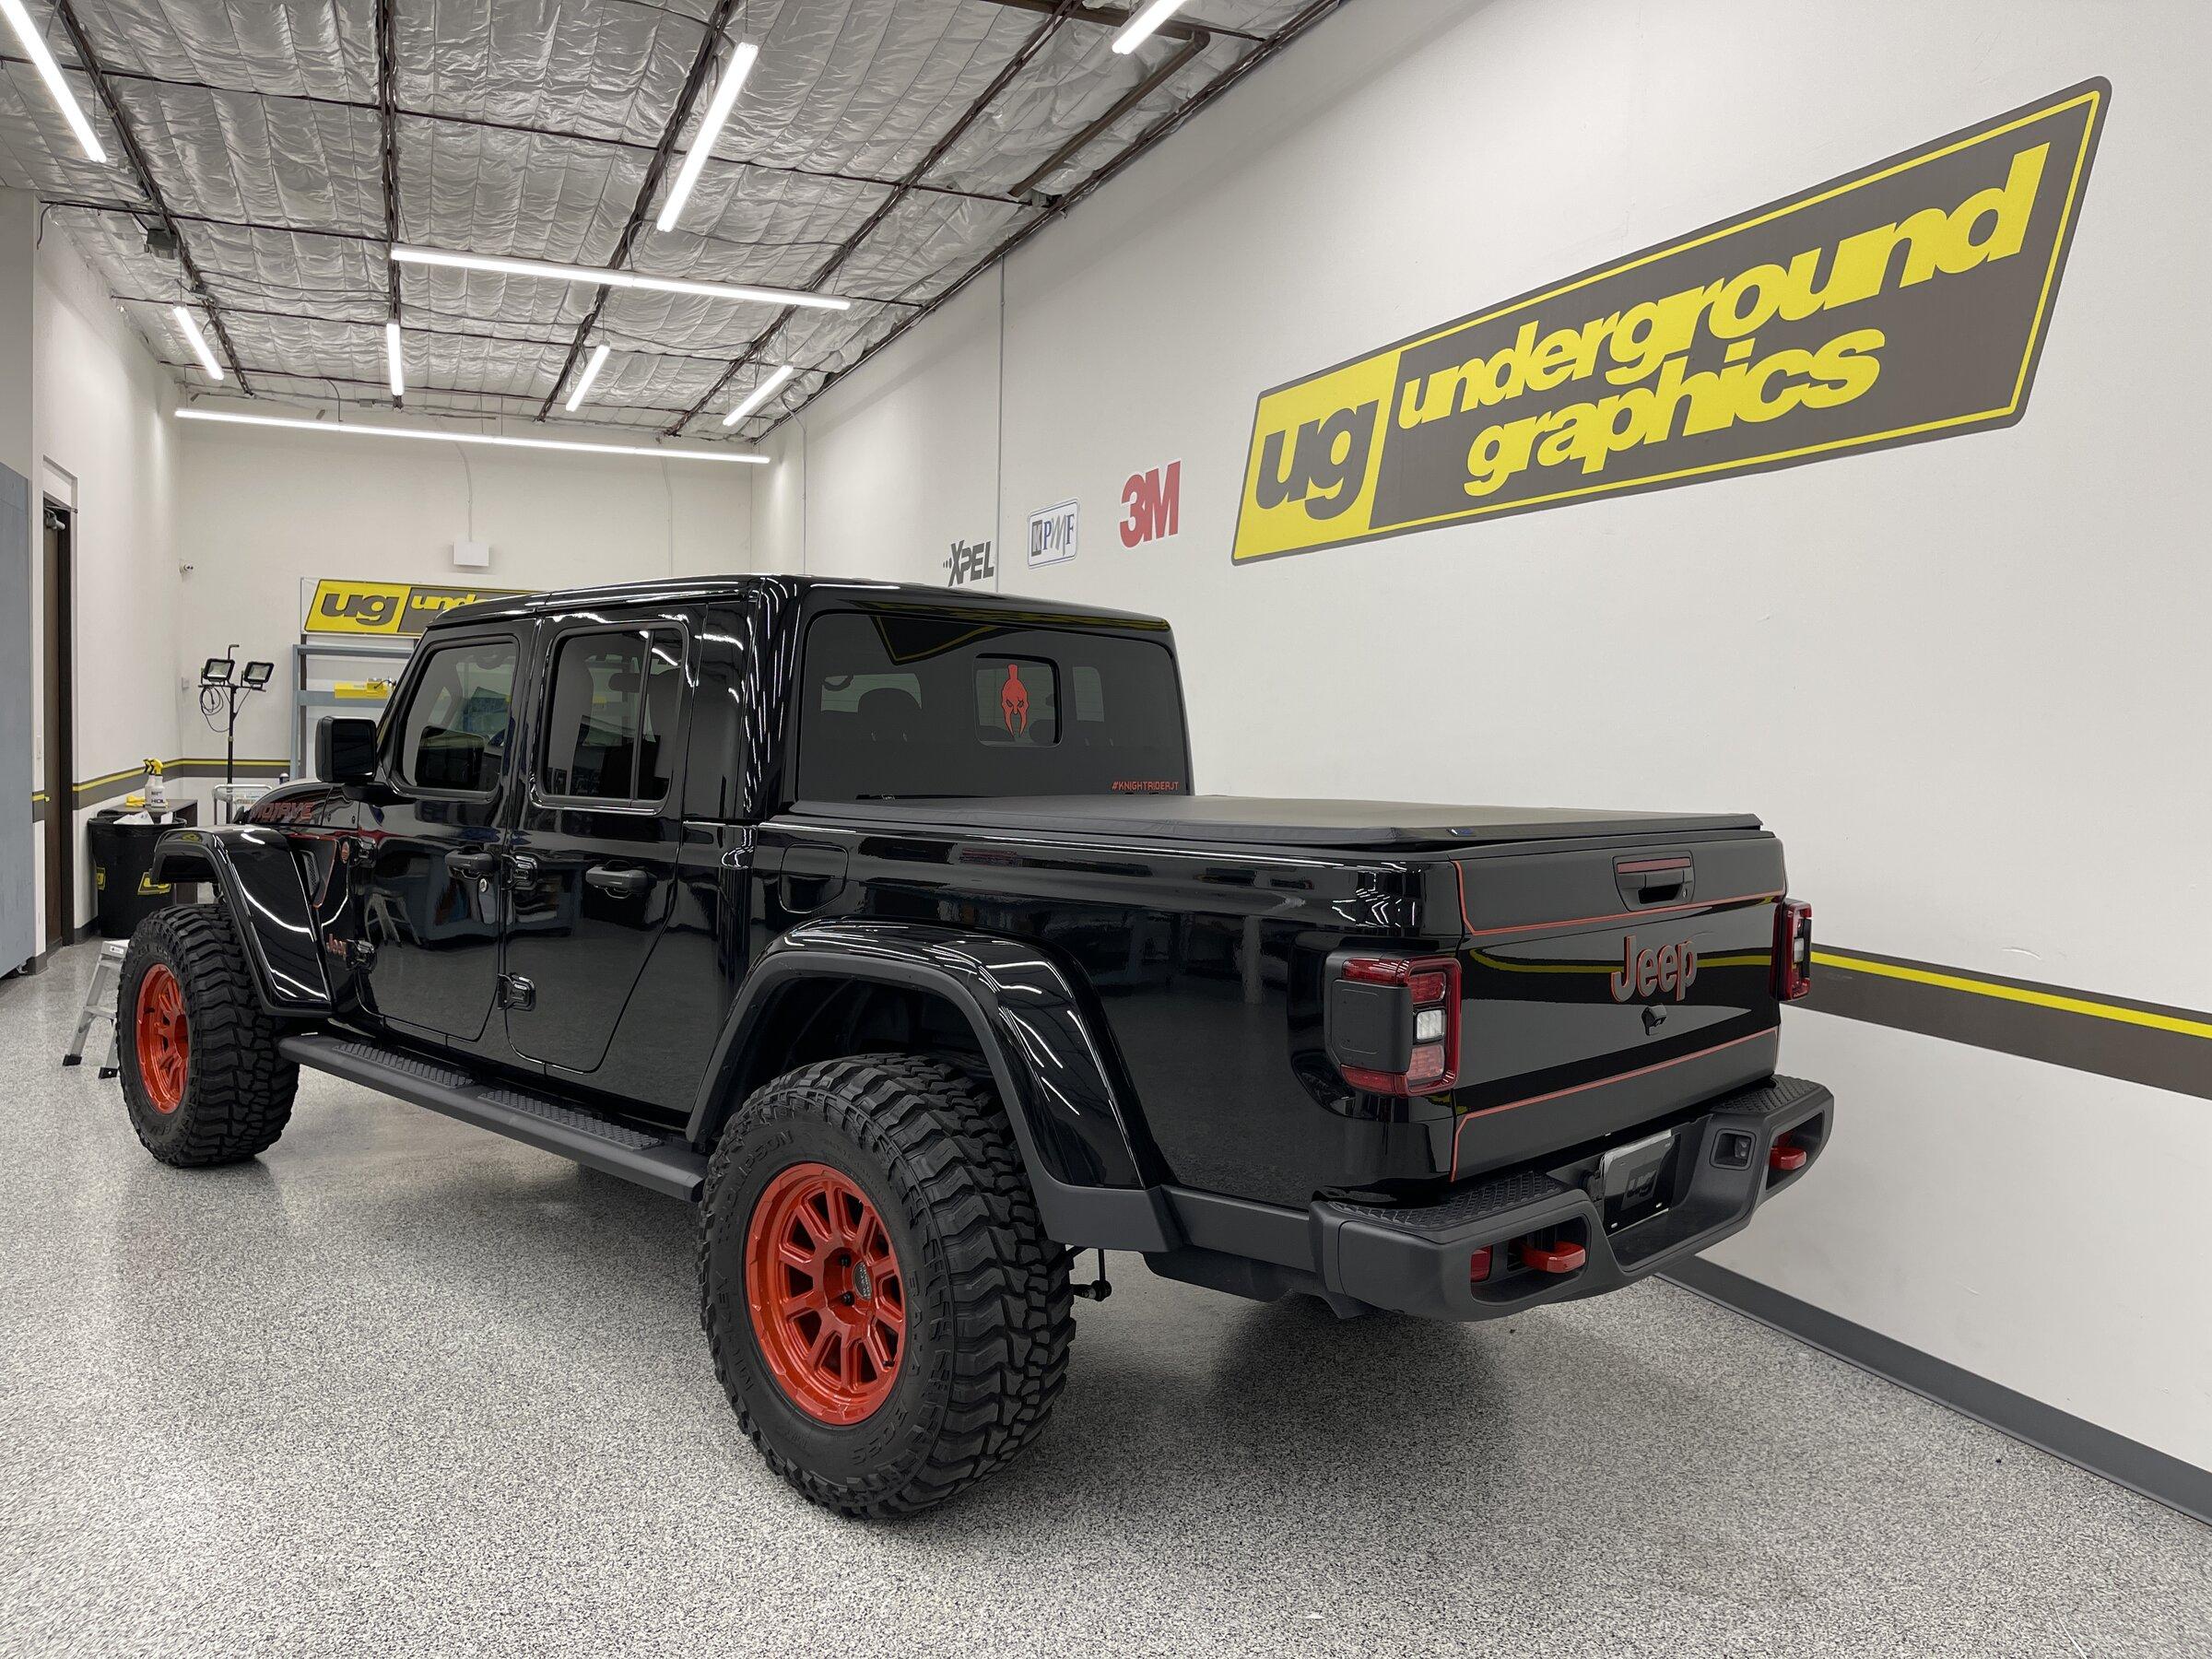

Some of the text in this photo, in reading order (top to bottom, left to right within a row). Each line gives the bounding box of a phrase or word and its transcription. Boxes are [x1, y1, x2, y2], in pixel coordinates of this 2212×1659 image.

[1398, 141, 2051, 429] underground
[1464, 328, 1885, 495] graphics
[1256, 398, 1378, 519] ug
[1030, 513, 1075, 558] KPMF
[1119, 460, 1181, 547] 3M
[947, 539, 994, 587] XPEL
[321, 593, 398, 626] ug
[1611, 935, 1698, 1002] Jeep
